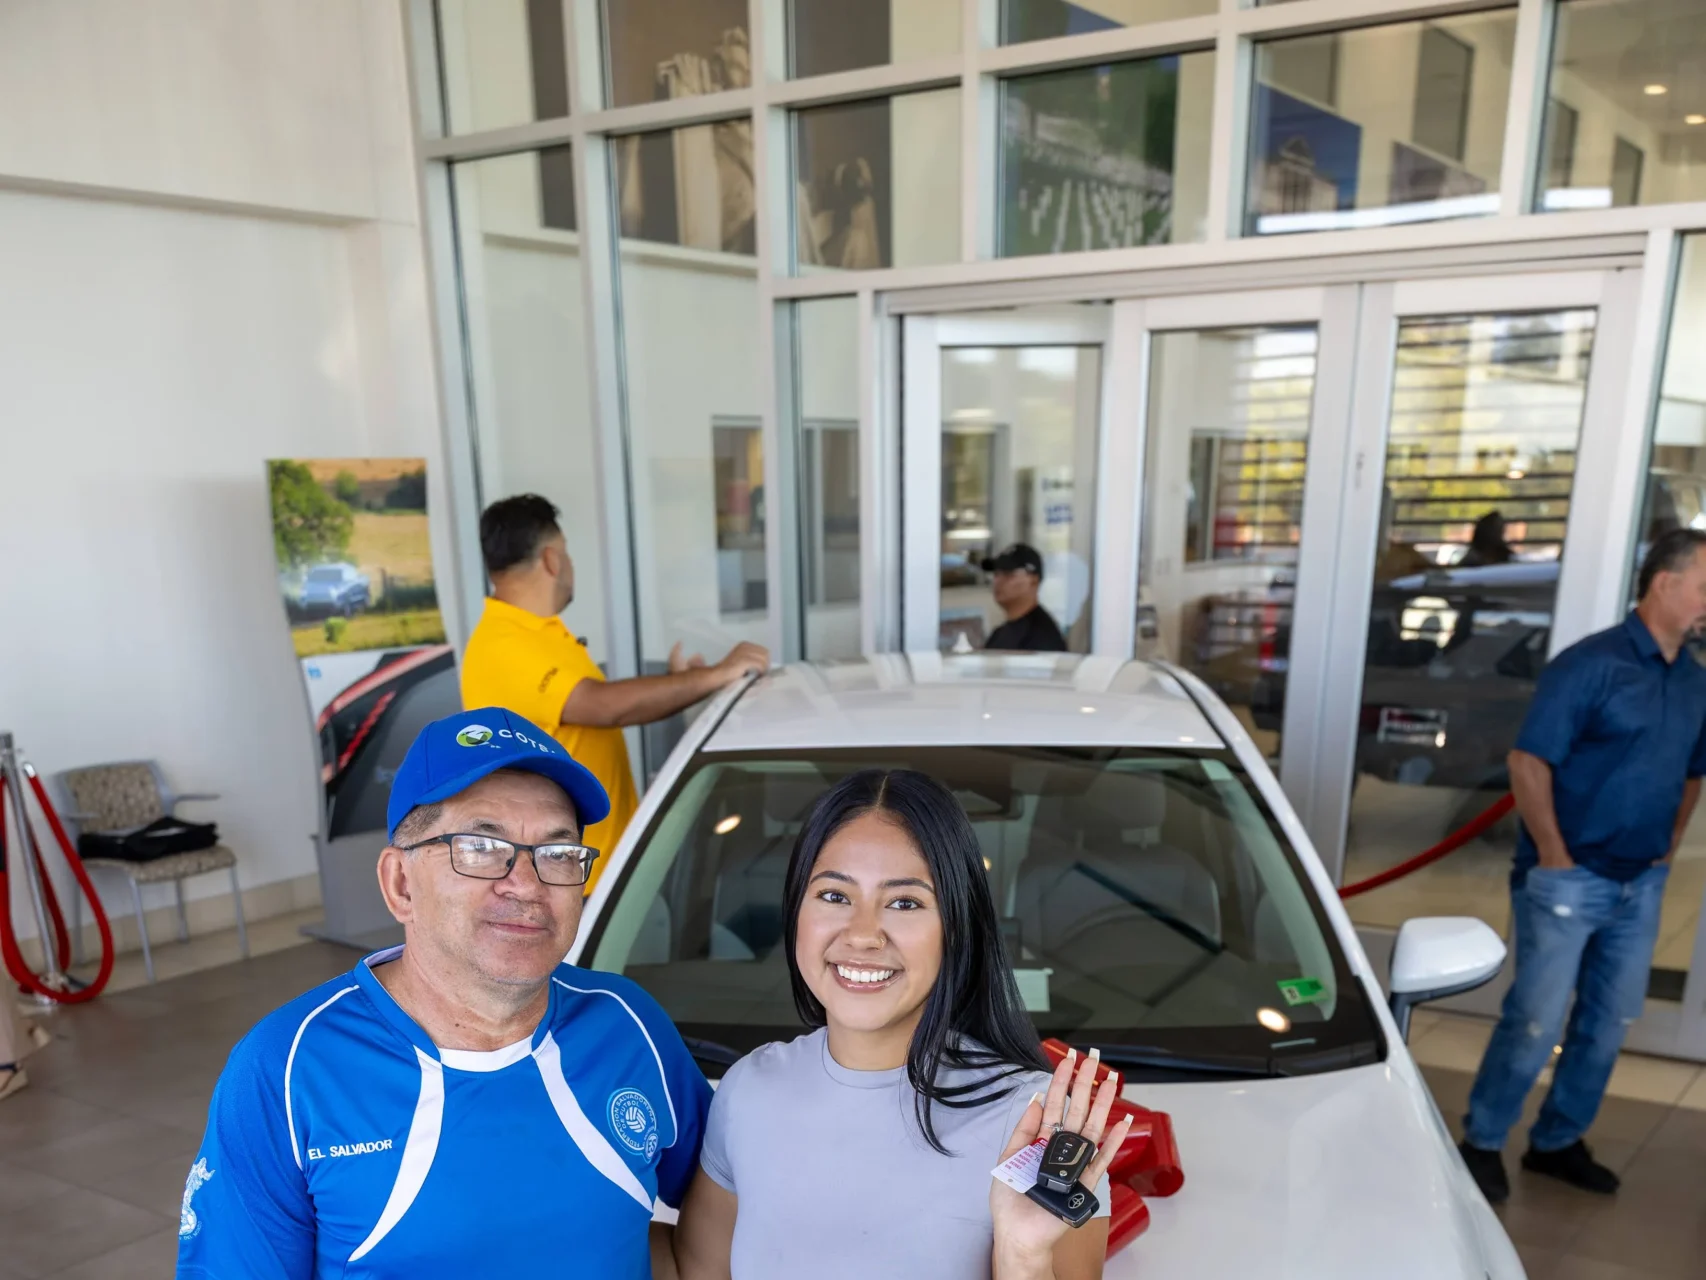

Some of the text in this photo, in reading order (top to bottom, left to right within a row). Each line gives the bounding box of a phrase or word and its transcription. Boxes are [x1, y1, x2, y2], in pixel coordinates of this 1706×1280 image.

[620, 1100, 640, 1116] FUTBOL
[308, 1139, 393, 1160] EL SALVADOR
